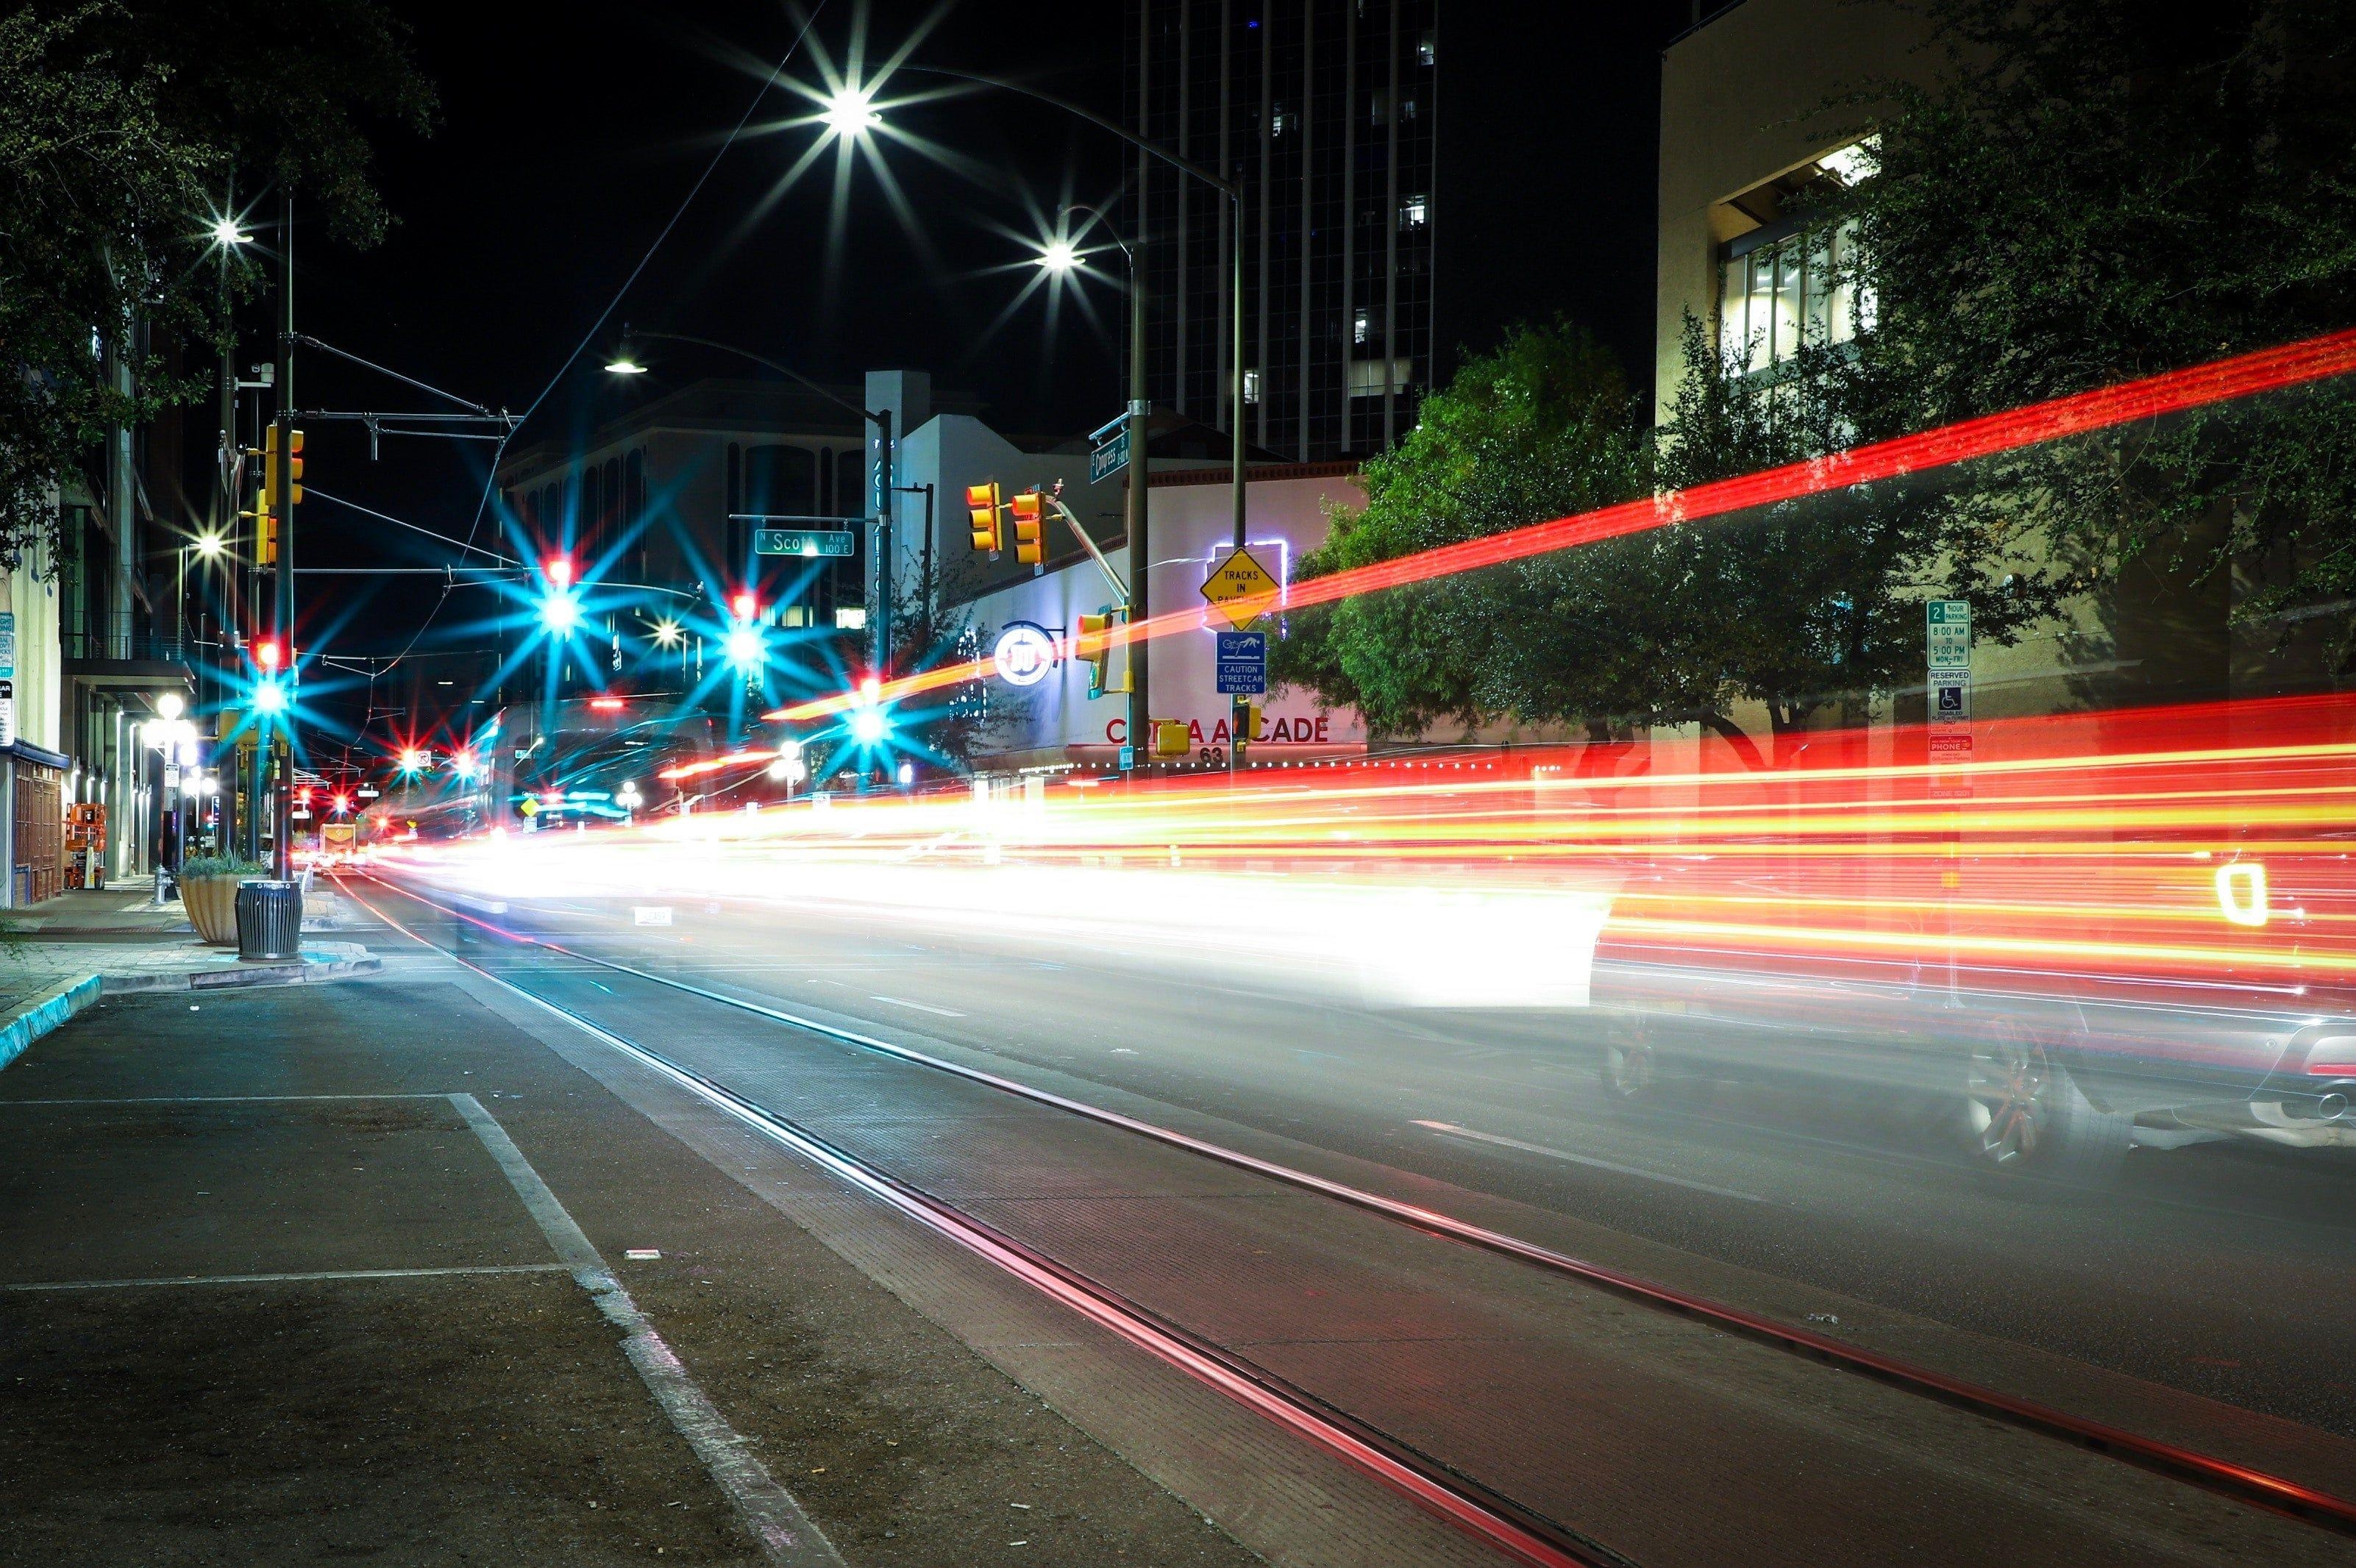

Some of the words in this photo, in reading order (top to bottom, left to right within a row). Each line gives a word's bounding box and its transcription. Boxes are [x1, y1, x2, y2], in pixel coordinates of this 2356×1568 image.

[760, 532, 766, 541] N
[829, 534, 845, 544] Ave
[825, 544, 840, 554] 100
[844, 544, 849, 554] E
[1225, 570, 1259, 580] TRACKS
[1236, 583, 1246, 593] IN
[1933, 607, 1940, 619] 2
[1933, 627, 1951, 635] 8:00
[1954, 627, 1965, 635] AM
[1933, 646, 1951, 655] 5:00
[1954, 645, 1965, 655] PM
[1219, 674, 1263, 683] STREETCAR
[1225, 684, 1256, 692] TRACKS
[1211, 717, 1328, 743] ACADE
[1199, 747, 1223, 763] 63
